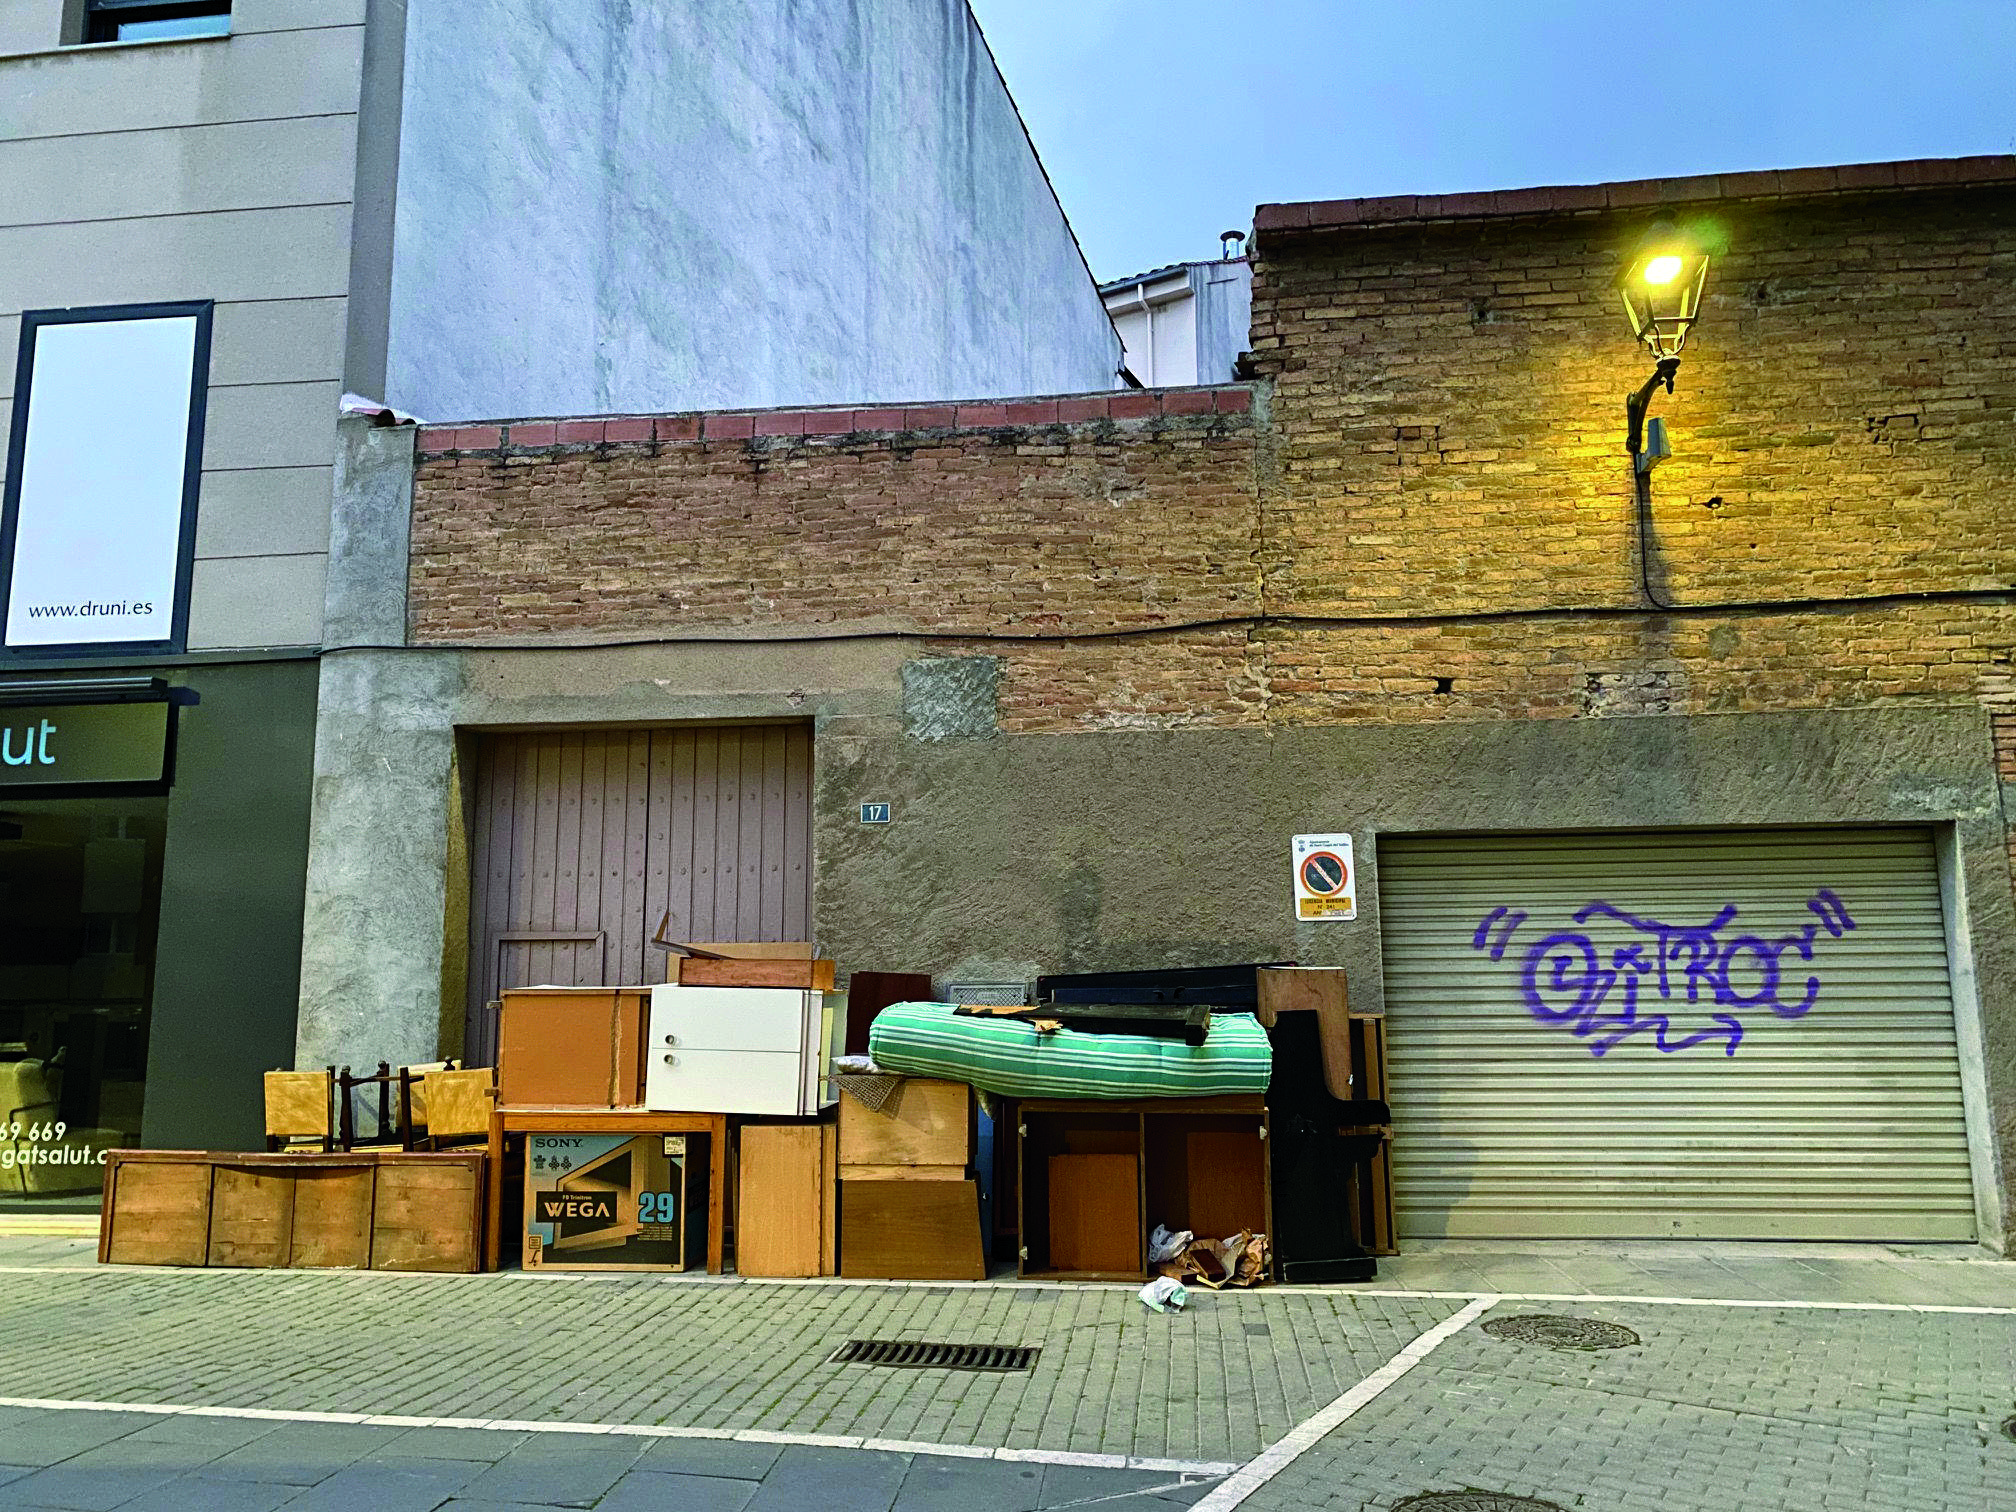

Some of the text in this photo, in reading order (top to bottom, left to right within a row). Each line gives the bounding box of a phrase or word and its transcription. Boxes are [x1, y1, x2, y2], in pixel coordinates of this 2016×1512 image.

[28, 600, 153, 618] www.druni.es
[2, 719, 57, 766] ut
[869, 805, 882, 821] 17
[28, 1121, 67, 1142] 669
[535, 1138, 583, 1148] SONY
[544, 1201, 610, 1218] WEGA
[638, 1191, 674, 1224] 29
